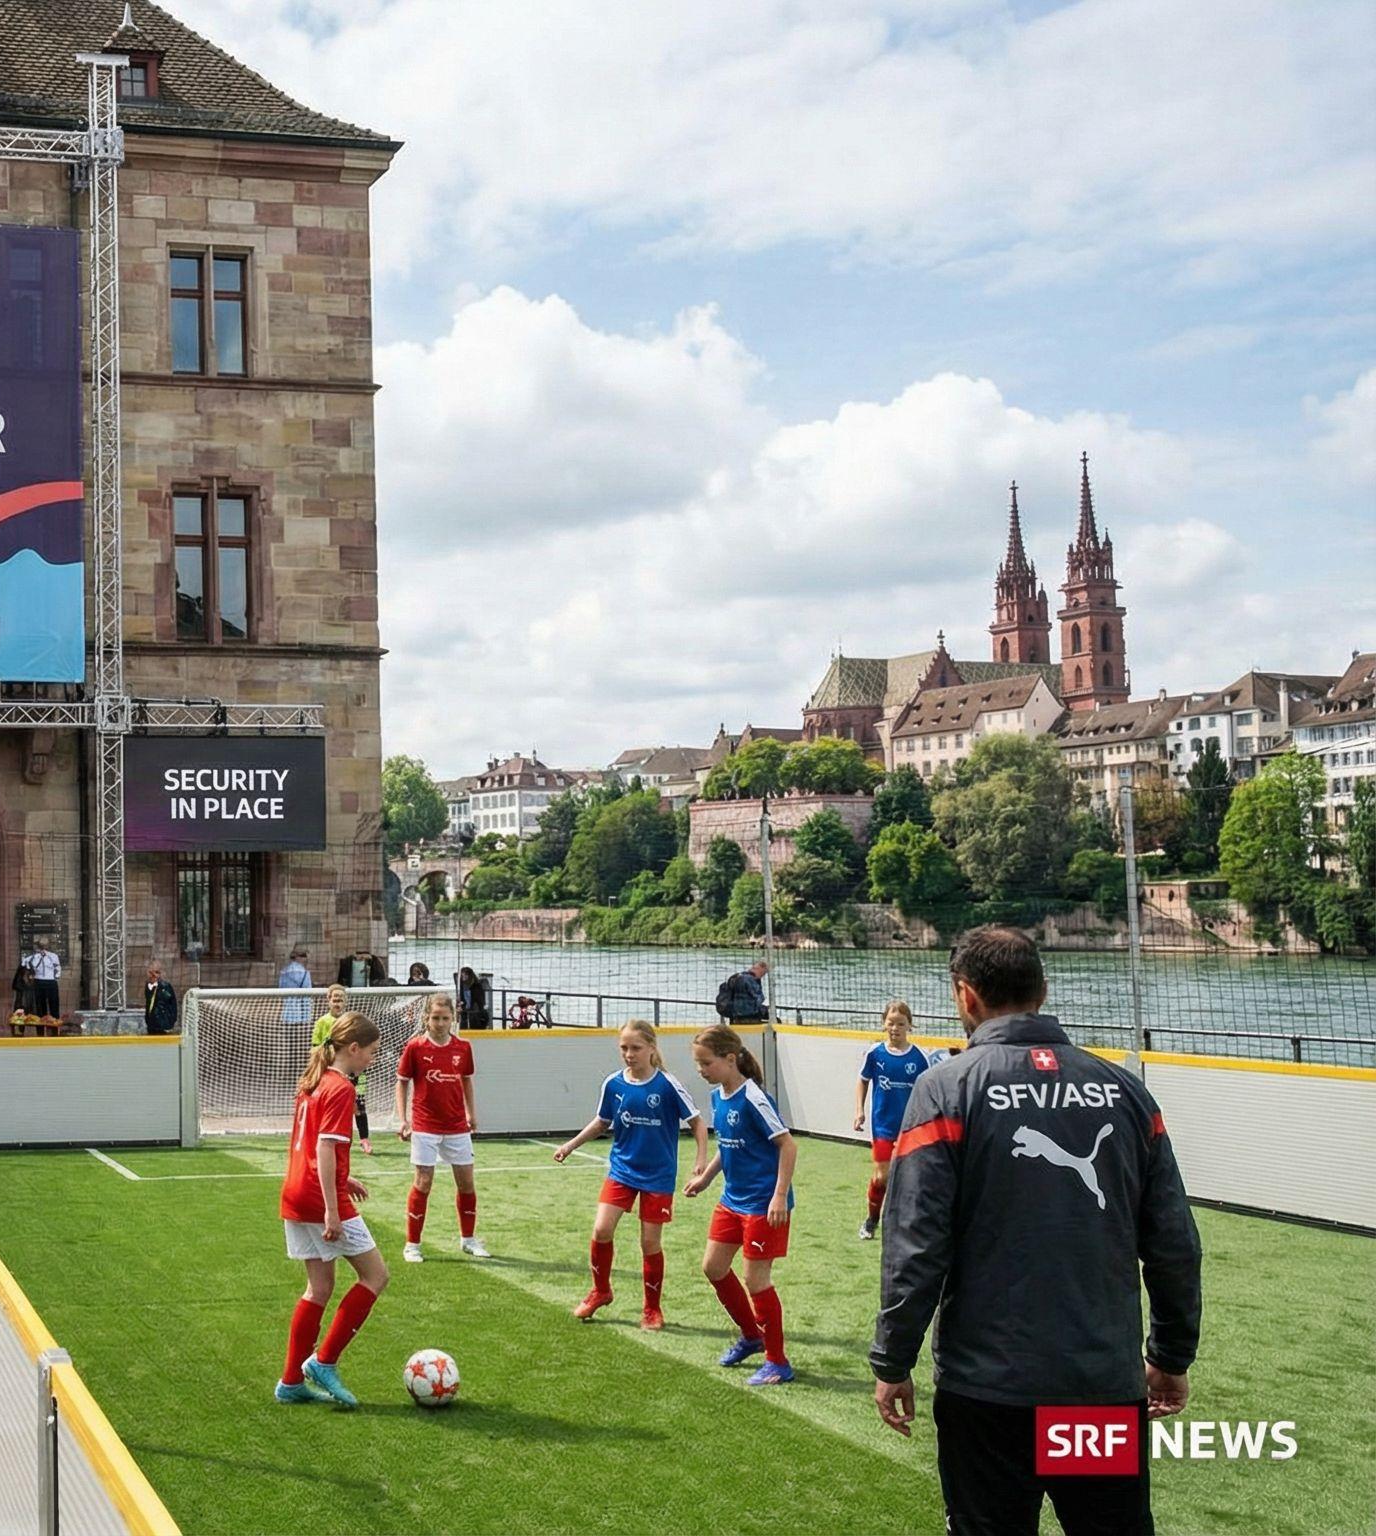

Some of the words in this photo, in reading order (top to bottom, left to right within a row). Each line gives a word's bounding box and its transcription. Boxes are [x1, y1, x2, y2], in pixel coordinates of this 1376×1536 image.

[164, 768, 290, 791] SECURITY
[170, 797, 197, 820] IN
[204, 797, 285, 820] PLACE
[986, 1082, 1123, 1111] SFV/ASF
